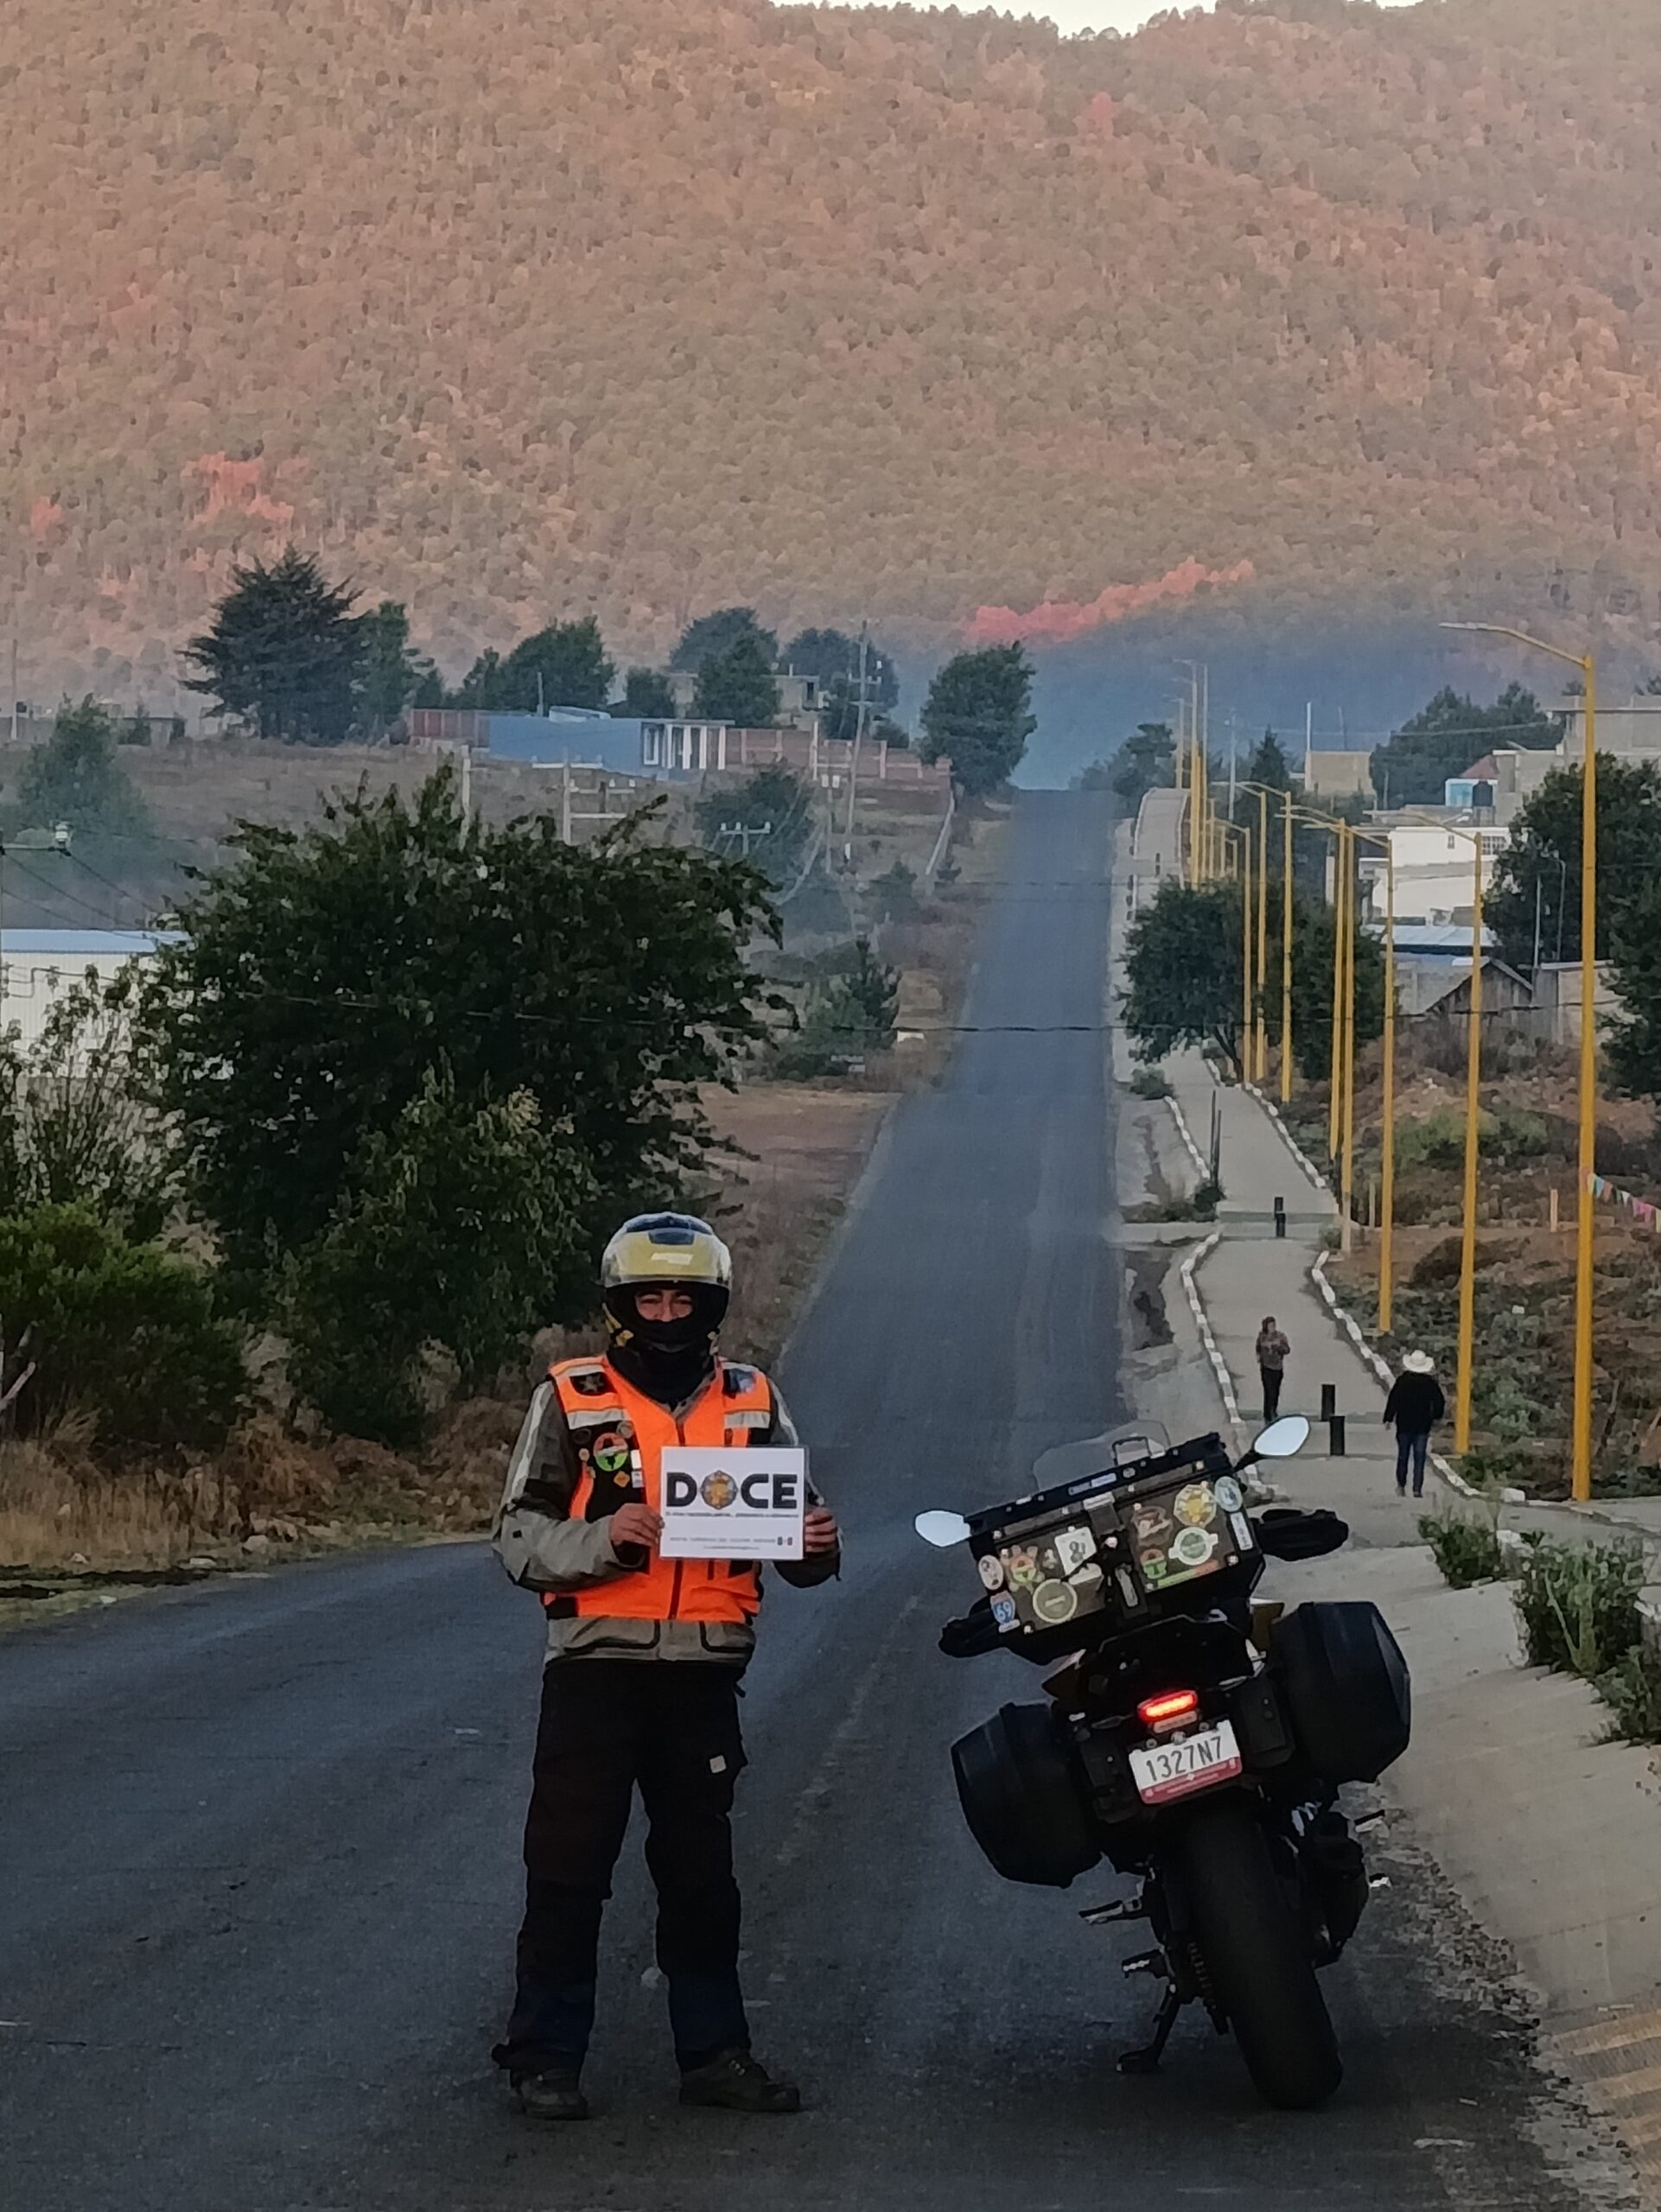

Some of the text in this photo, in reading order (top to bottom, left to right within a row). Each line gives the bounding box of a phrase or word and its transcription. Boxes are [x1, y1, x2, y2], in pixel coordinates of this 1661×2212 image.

[666, 1470, 798, 1510] DOCE
[996, 1601, 1012, 1621] 69
[1146, 1736, 1221, 1782] 1327N7
